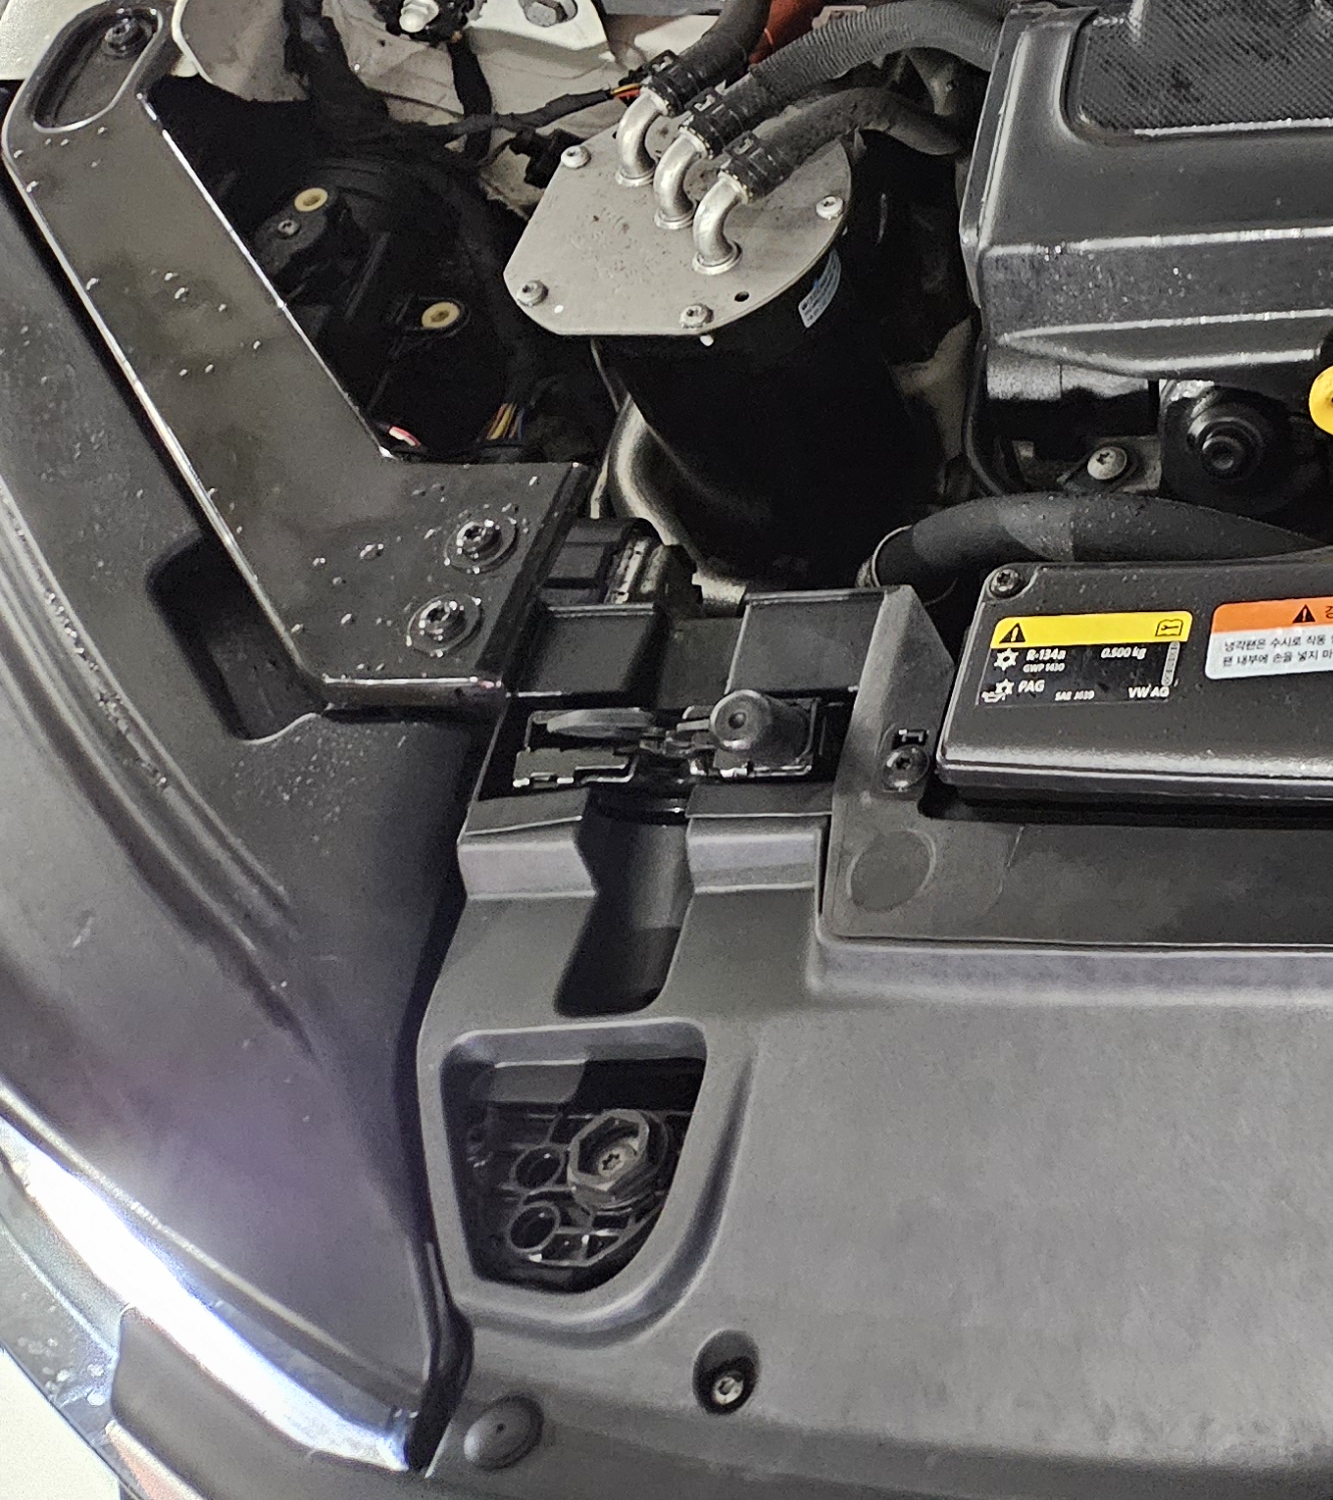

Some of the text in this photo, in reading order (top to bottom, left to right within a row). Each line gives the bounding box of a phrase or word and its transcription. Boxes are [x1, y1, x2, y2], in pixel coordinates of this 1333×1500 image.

[1223, 652, 1232, 667] 팬
[1236, 650, 1267, 666] 내부에
[1272, 649, 1292, 665] 손을
[1297, 648, 1318, 663] 넣지
[1018, 679, 1044, 695] PAG
[1128, 685, 1169, 701] VW AG
